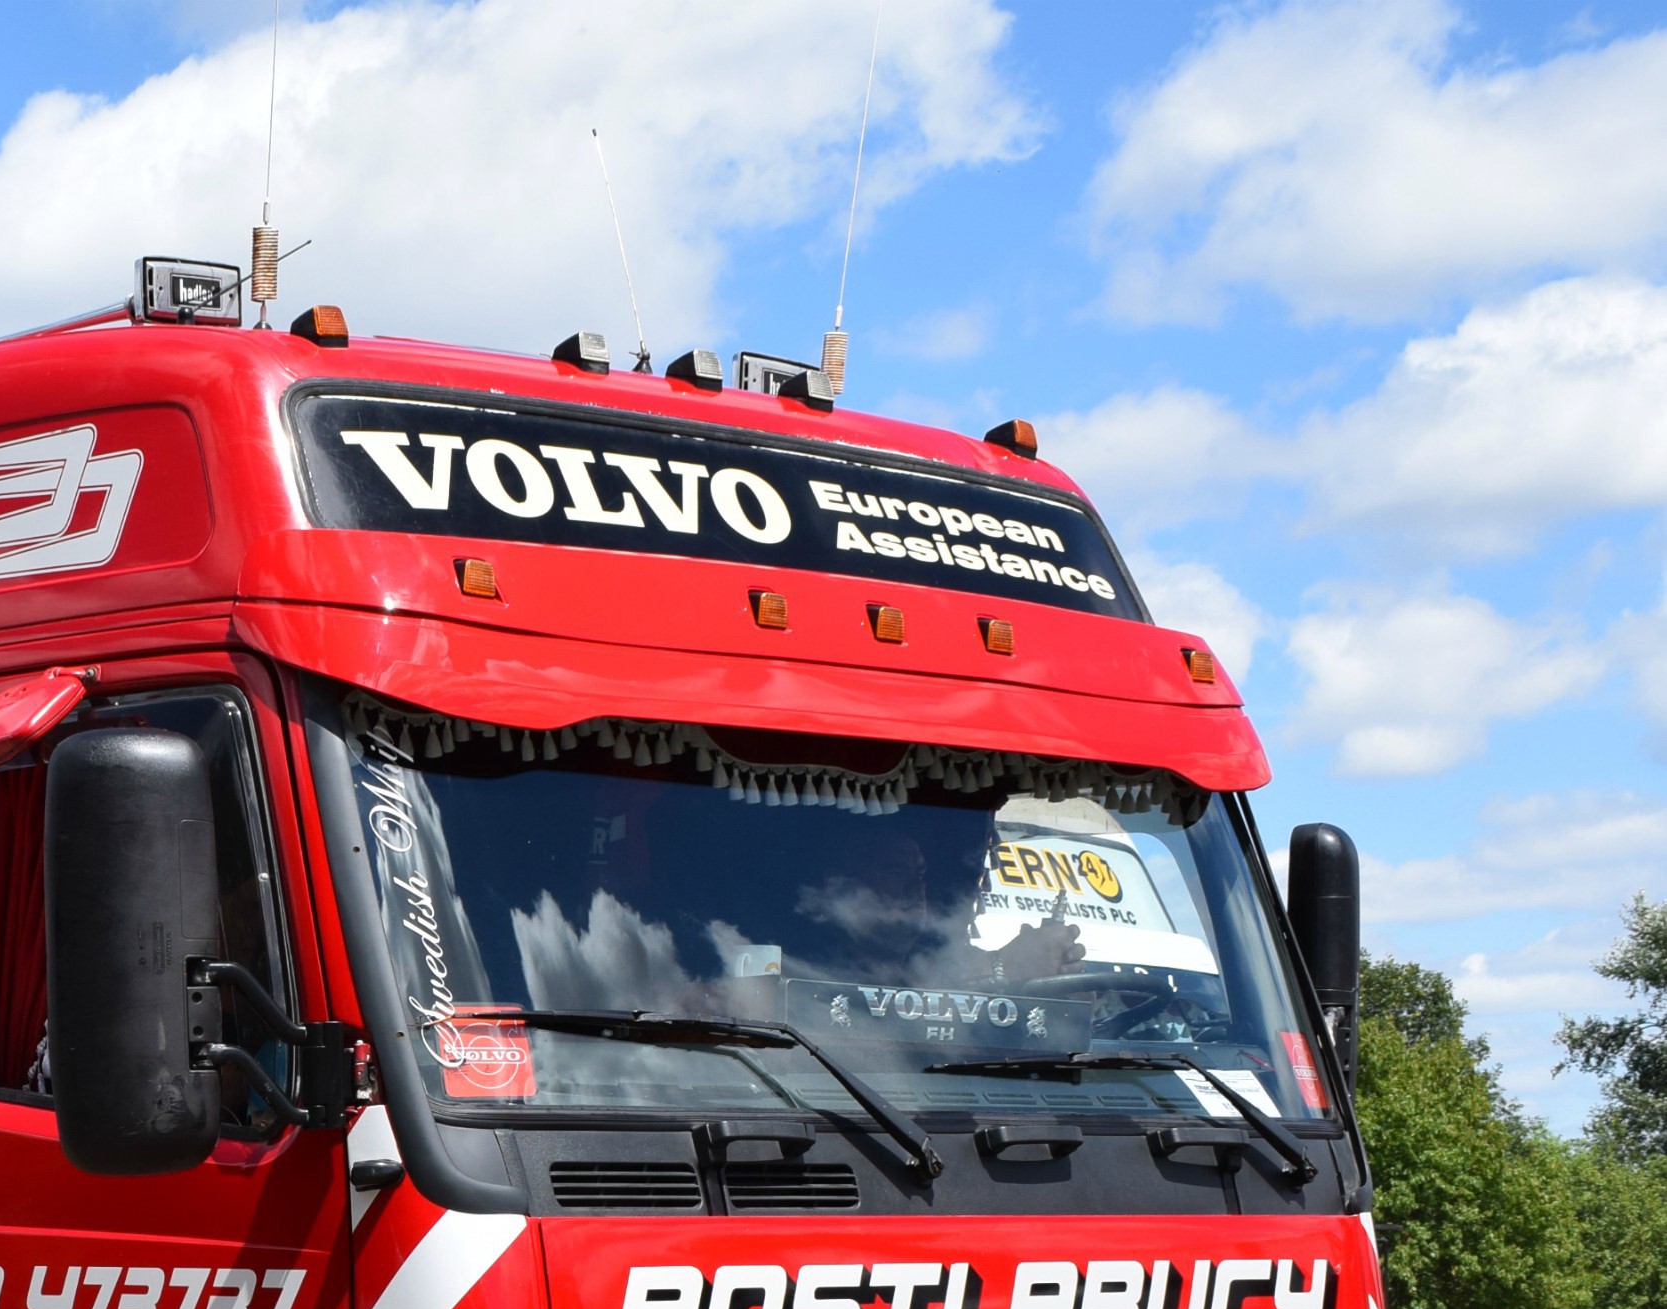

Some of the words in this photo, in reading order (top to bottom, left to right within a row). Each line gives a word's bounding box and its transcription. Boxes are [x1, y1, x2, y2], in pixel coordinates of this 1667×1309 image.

[341, 430, 791, 545] VOLVO
[809, 480, 1065, 552] European
[836, 521, 1116, 600] Assistance
[1015, 896, 1107, 920] SPECLISTS
[1109, 908, 1136, 925] PLC
[393, 871, 465, 1068] Swedish
[858, 986, 1017, 1026] VOLVO
[926, 1026, 955, 1041] FH
